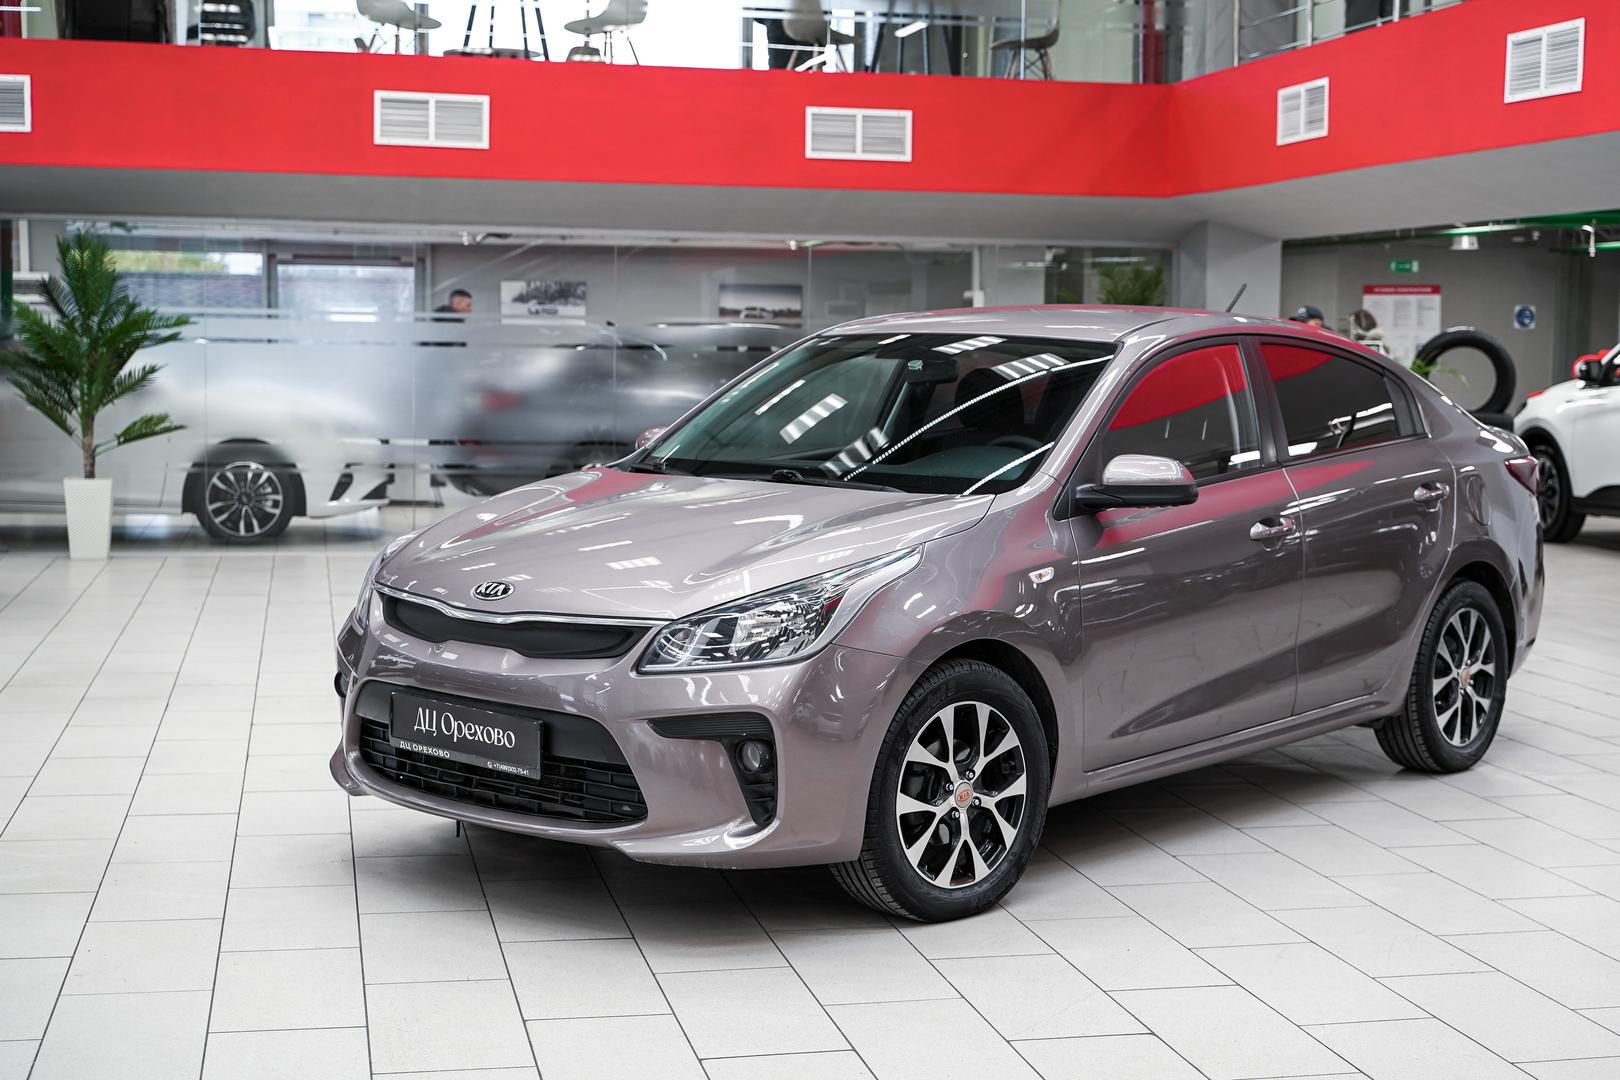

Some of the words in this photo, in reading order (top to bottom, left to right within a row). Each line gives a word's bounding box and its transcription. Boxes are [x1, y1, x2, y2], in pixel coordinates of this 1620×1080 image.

[477, 582, 505, 595] KIA
[414, 707, 437, 736] ДЦ
[441, 712, 515, 748] Орехово
[400, 741, 411, 750] ДЦ
[412, 743, 450, 758] ОРЕХОВО
